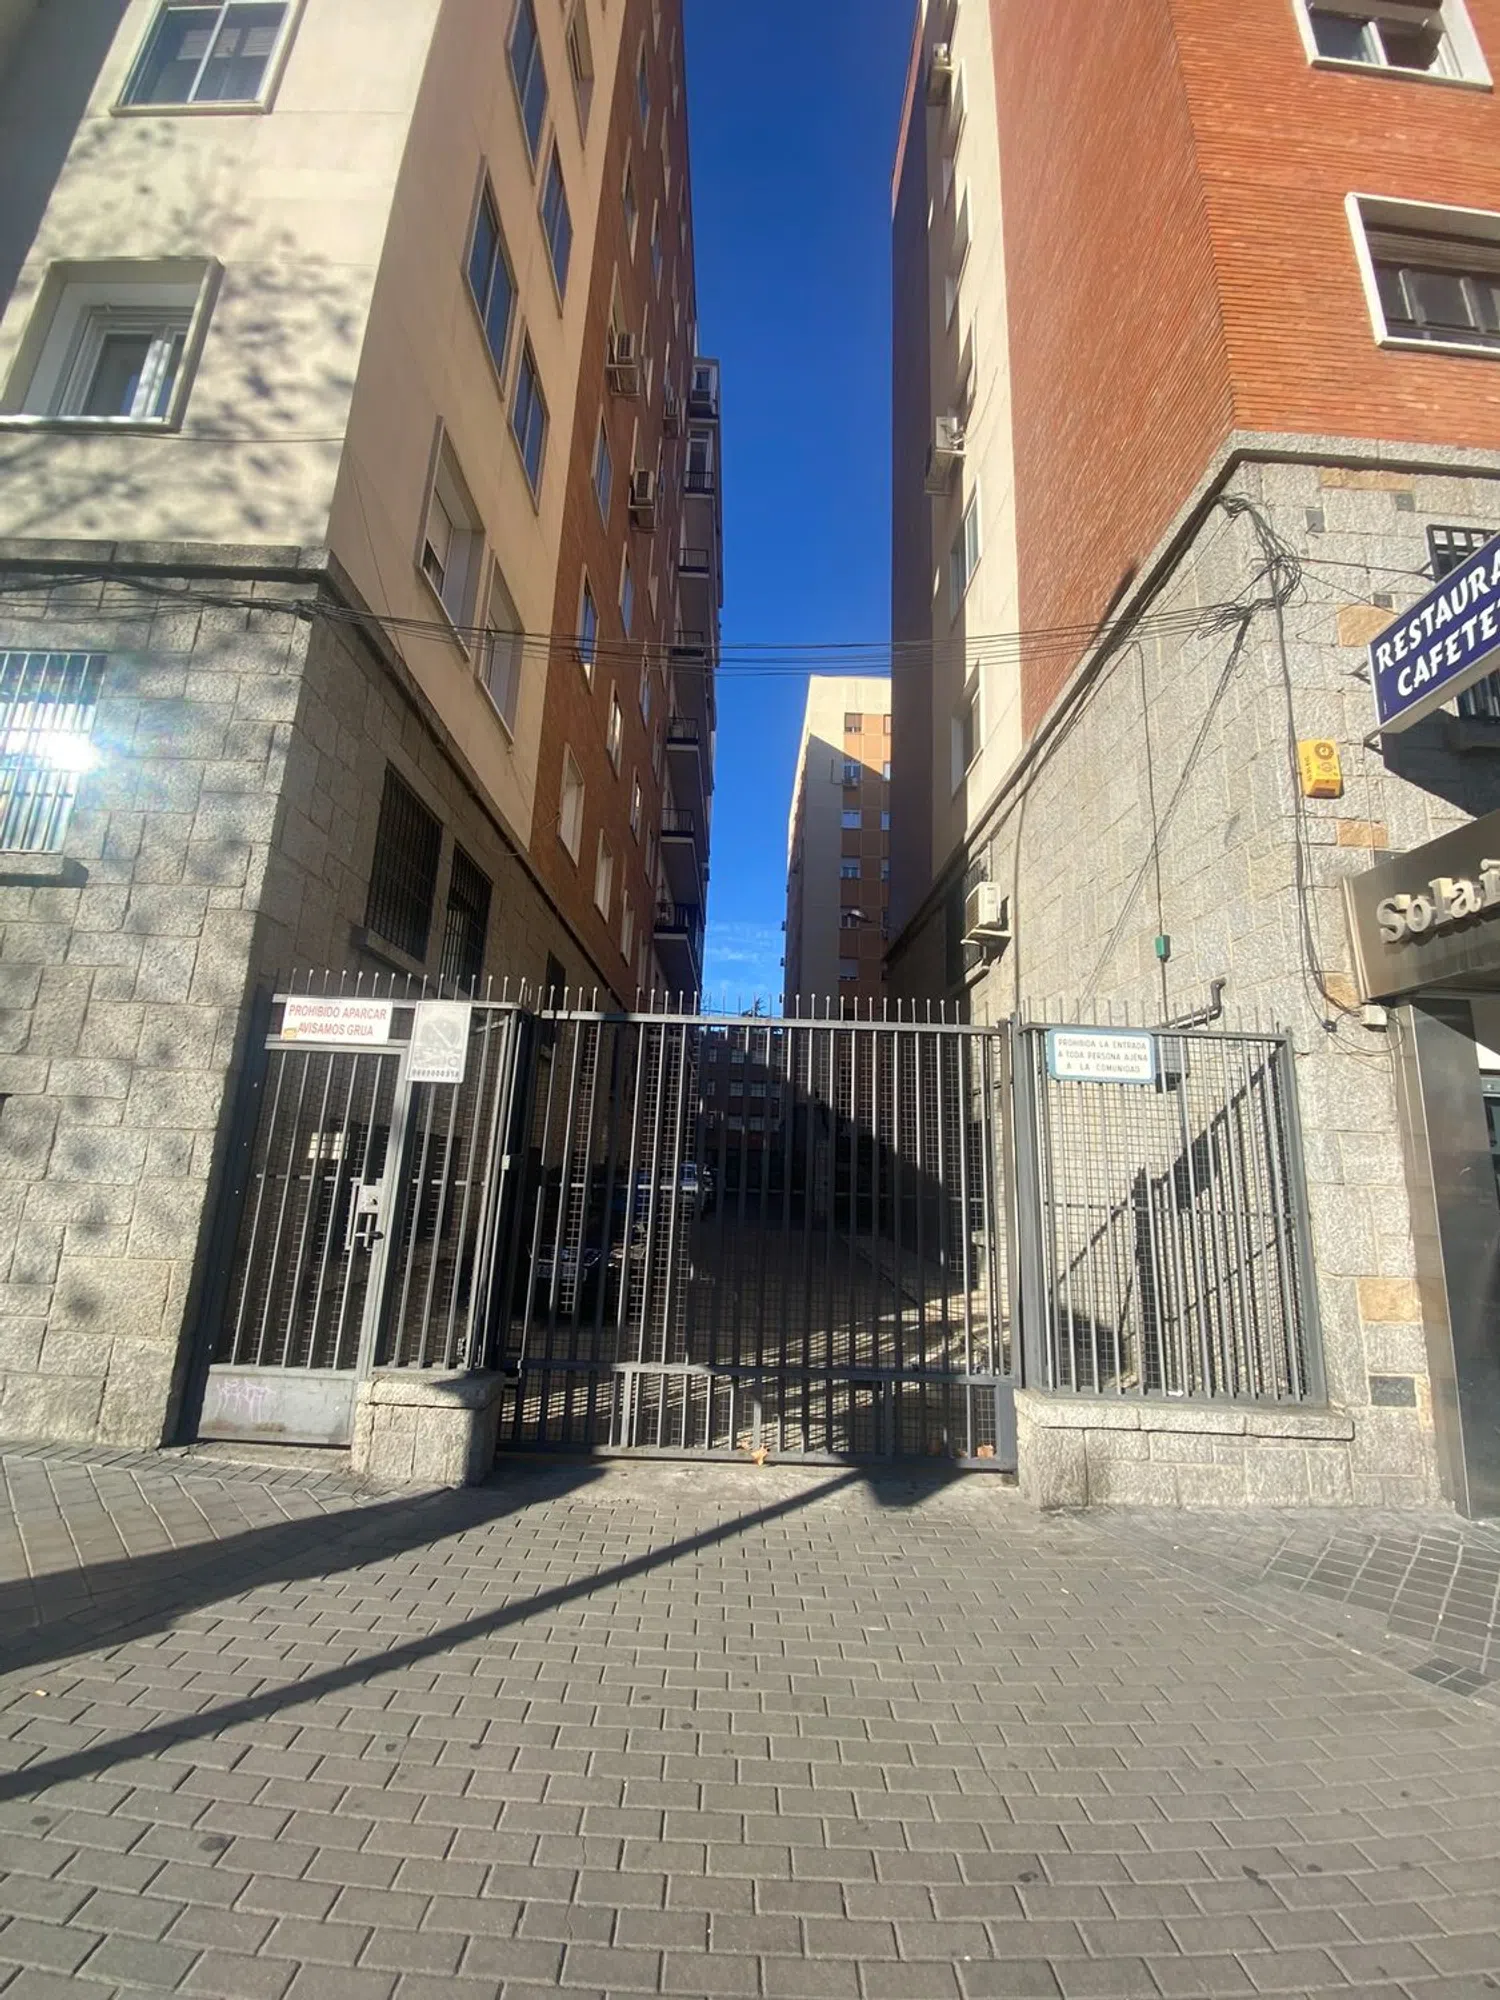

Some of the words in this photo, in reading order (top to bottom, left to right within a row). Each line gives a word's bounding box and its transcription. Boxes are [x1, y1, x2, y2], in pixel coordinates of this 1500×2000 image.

[1397, 598, 1500, 697] CAFETE
[288, 1004, 340, 1017] PROHIBIDO
[341, 1007, 388, 1020] APARCAR
[297, 1022, 345, 1036] AVISAMOS
[346, 1024, 374, 1037] GRUA
[1099, 1040, 1109, 1048] LA
[1112, 1041, 1147, 1050] ENTRADA
[1057, 1050, 1063, 1058] A
[1066, 1051, 1085, 1059] TODA
[1087, 1051, 1121, 1060] PERSONA
[1123, 1053, 1148, 1062] AJENA
[1066, 1062, 1072, 1070] A
[1079, 1063, 1090, 1071] LA
[1095, 1063, 1141, 1073] COMUNIDAD
